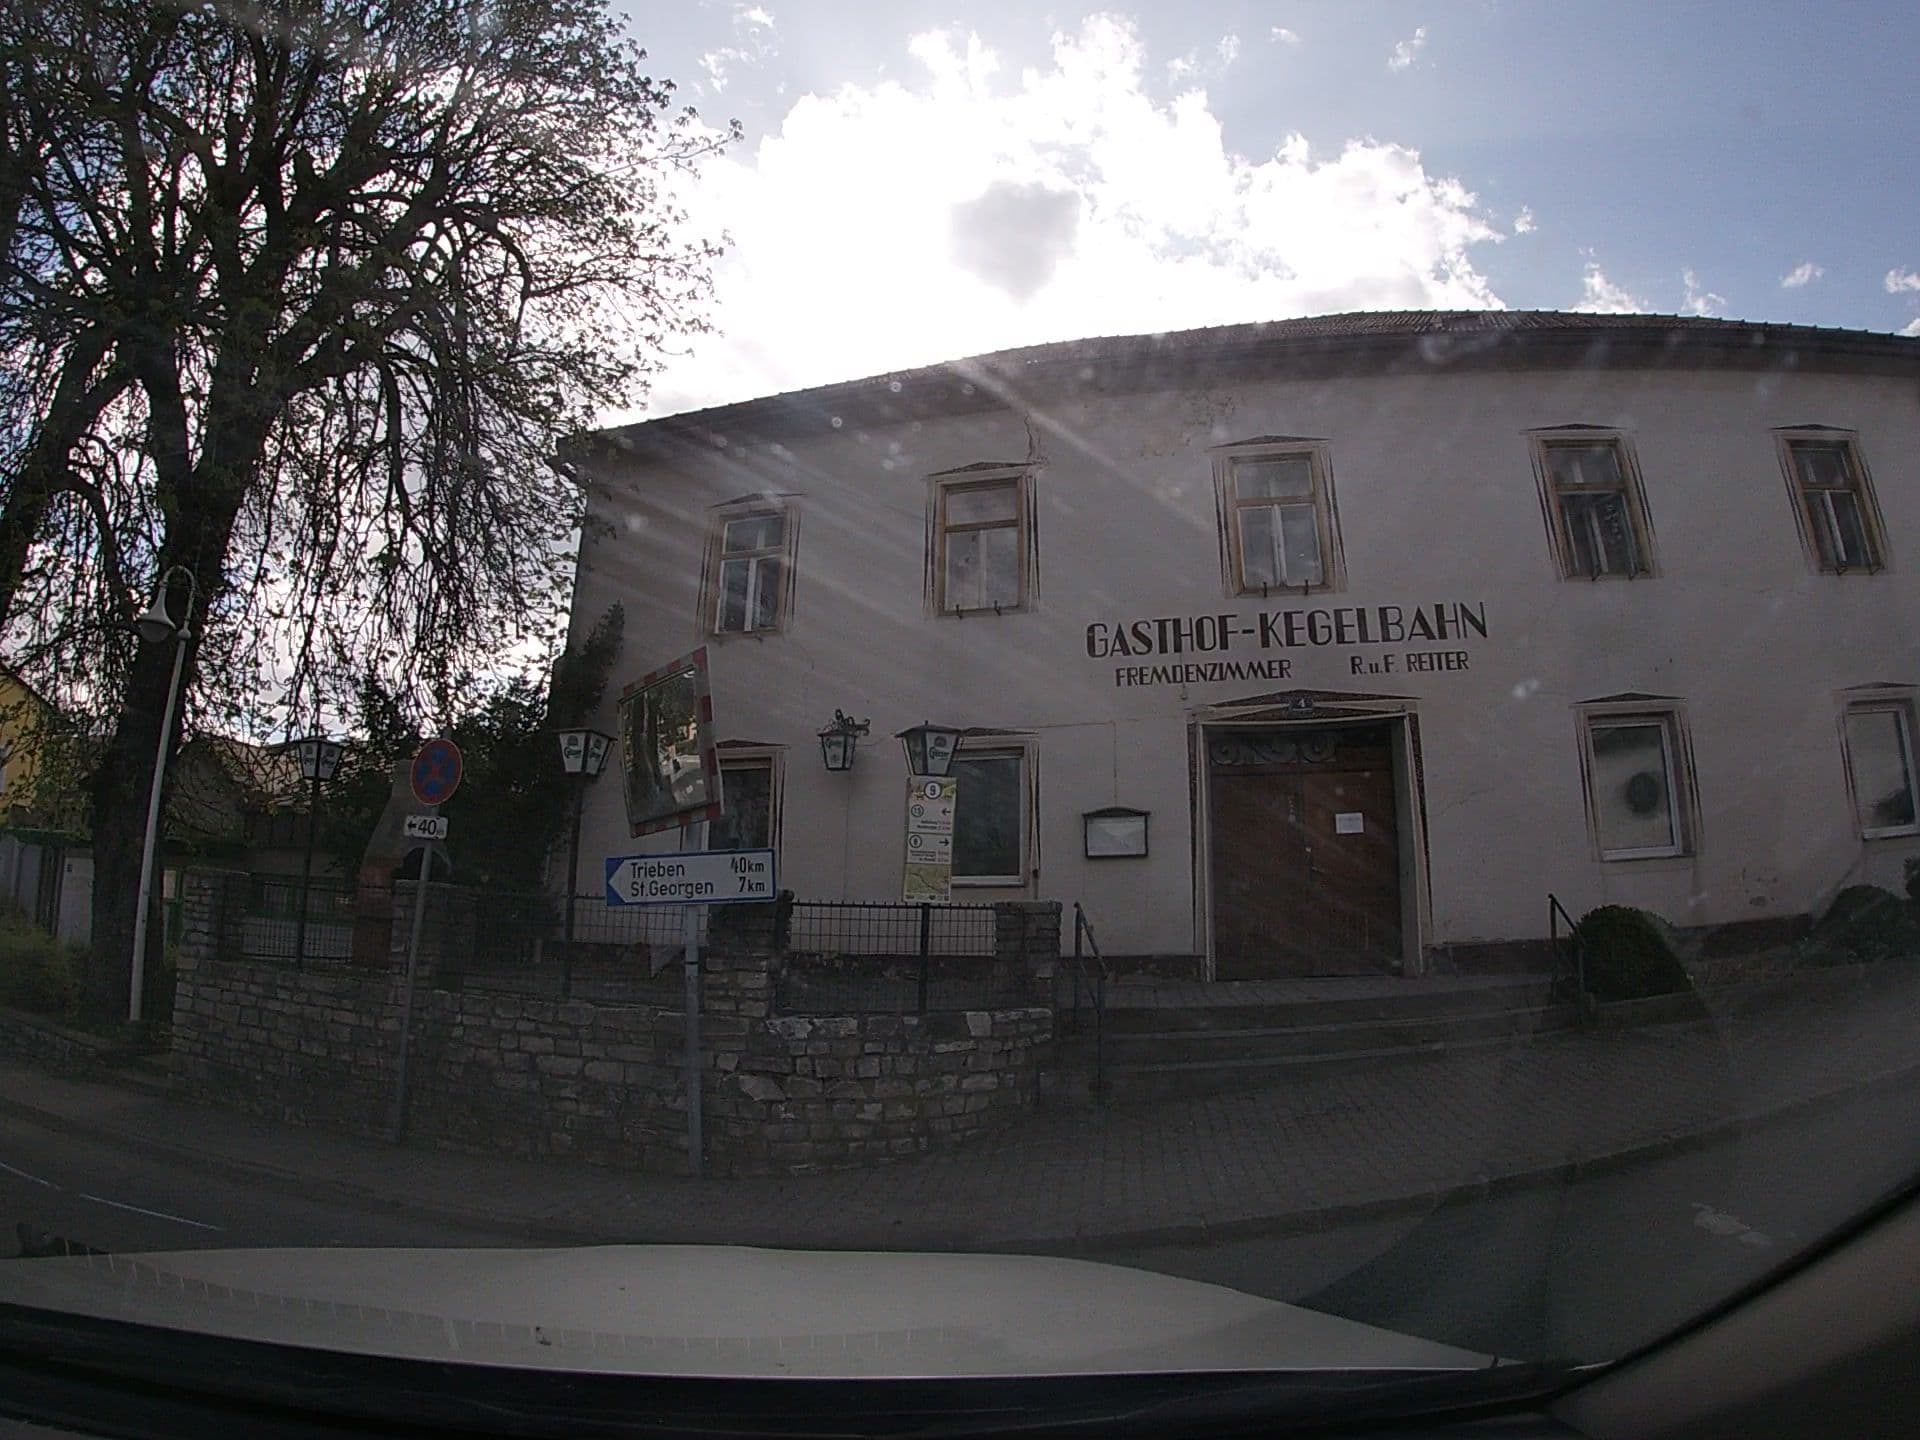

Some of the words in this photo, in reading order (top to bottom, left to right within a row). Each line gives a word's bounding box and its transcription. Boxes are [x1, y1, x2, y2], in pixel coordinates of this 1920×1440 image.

[1086, 602, 1488, 658] GASTHOF-KEGELBAHN
[1115, 659, 1291, 686] FREMDENZIMMER
[1407, 651, 1469, 673] REITER
[418, 819, 437, 835] 40
[631, 861, 685, 878] Trieben
